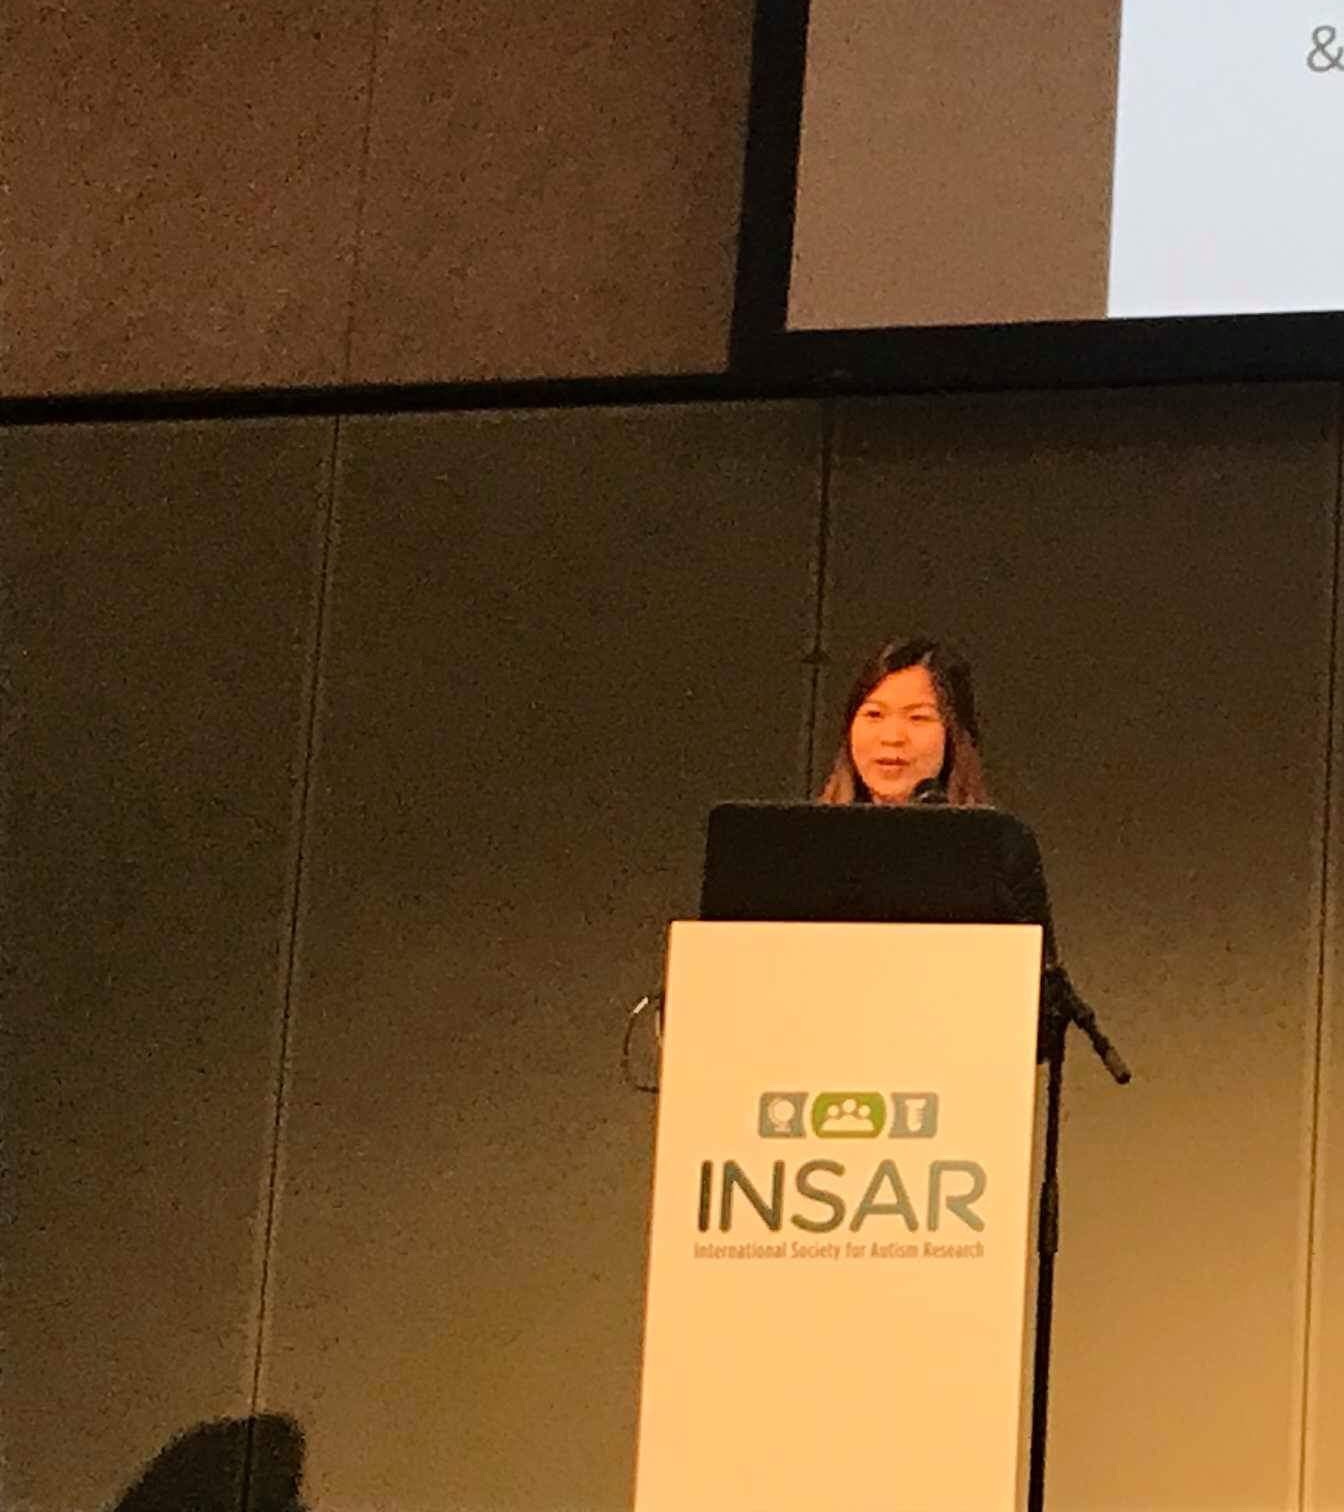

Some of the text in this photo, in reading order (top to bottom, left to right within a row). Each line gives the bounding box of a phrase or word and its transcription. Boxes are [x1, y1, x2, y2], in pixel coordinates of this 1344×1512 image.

[697, 1158, 988, 1233] INSAR
[693, 1239, 986, 1262] International Society for Autism Research
